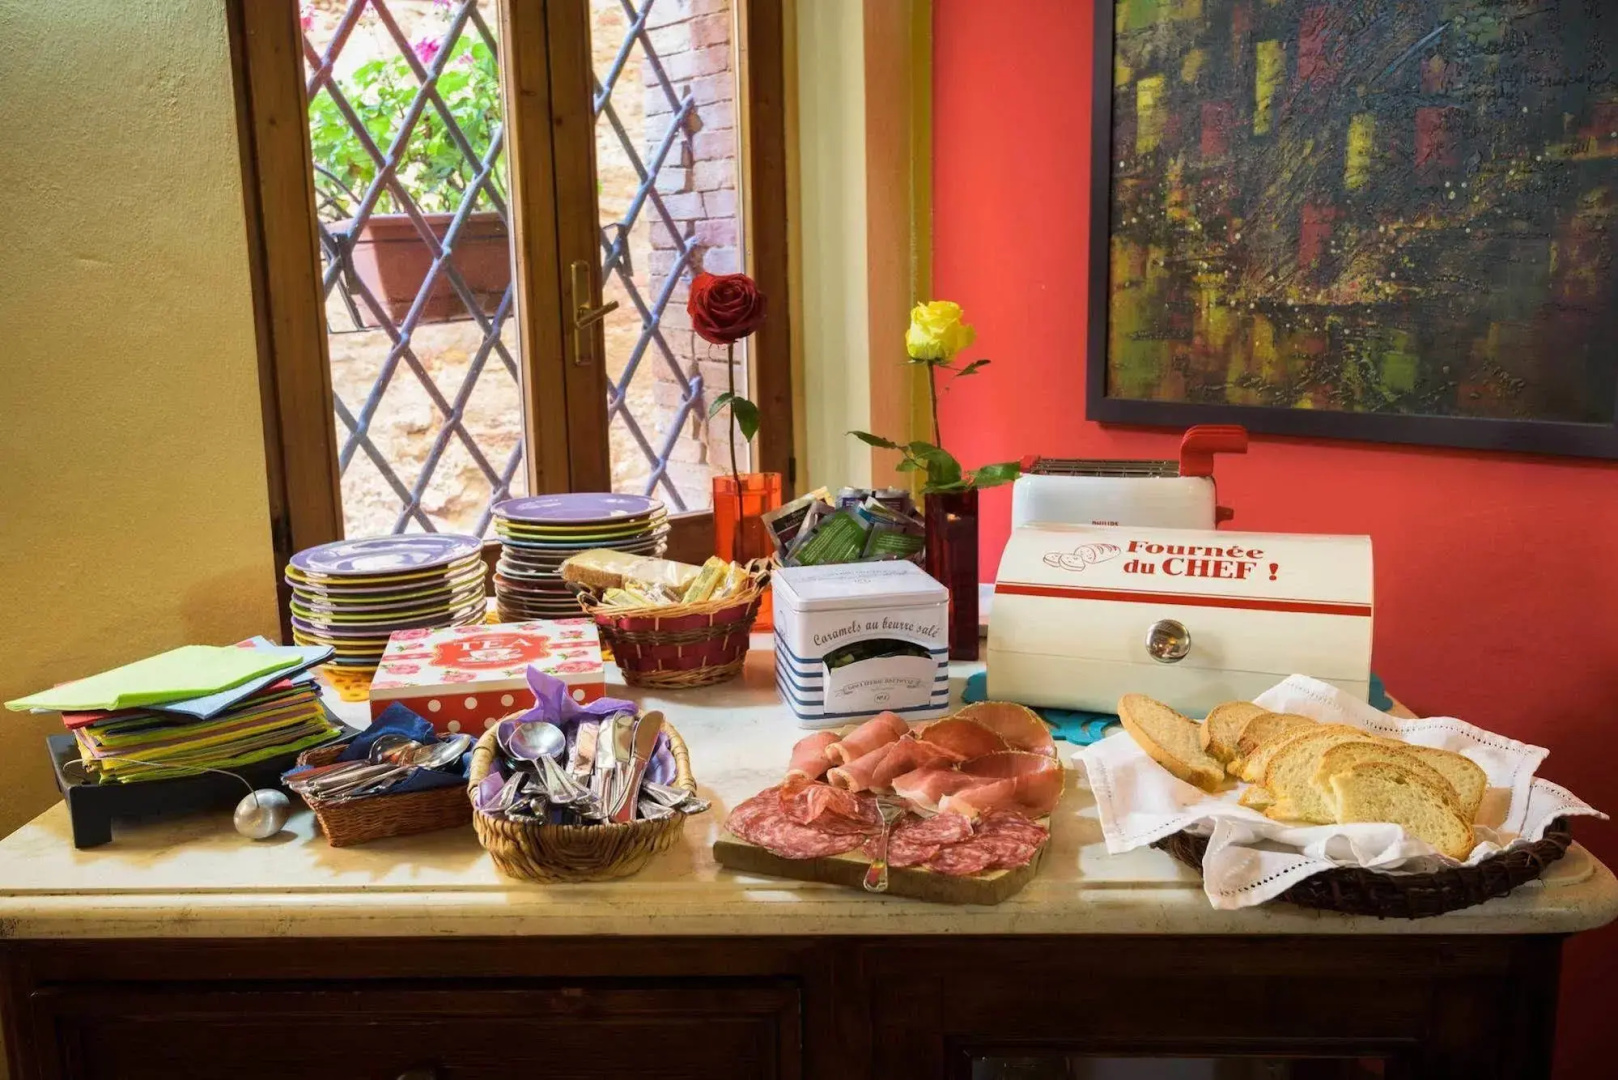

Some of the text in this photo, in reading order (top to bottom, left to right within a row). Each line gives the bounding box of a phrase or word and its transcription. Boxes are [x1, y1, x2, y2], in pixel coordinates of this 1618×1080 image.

[1127, 540, 1264, 559] Fournée
[1123, 557, 1279, 581] du CHEF !
[813, 616, 941, 647] Caramels au beurre salé
[454, 637, 533, 651] TEA
